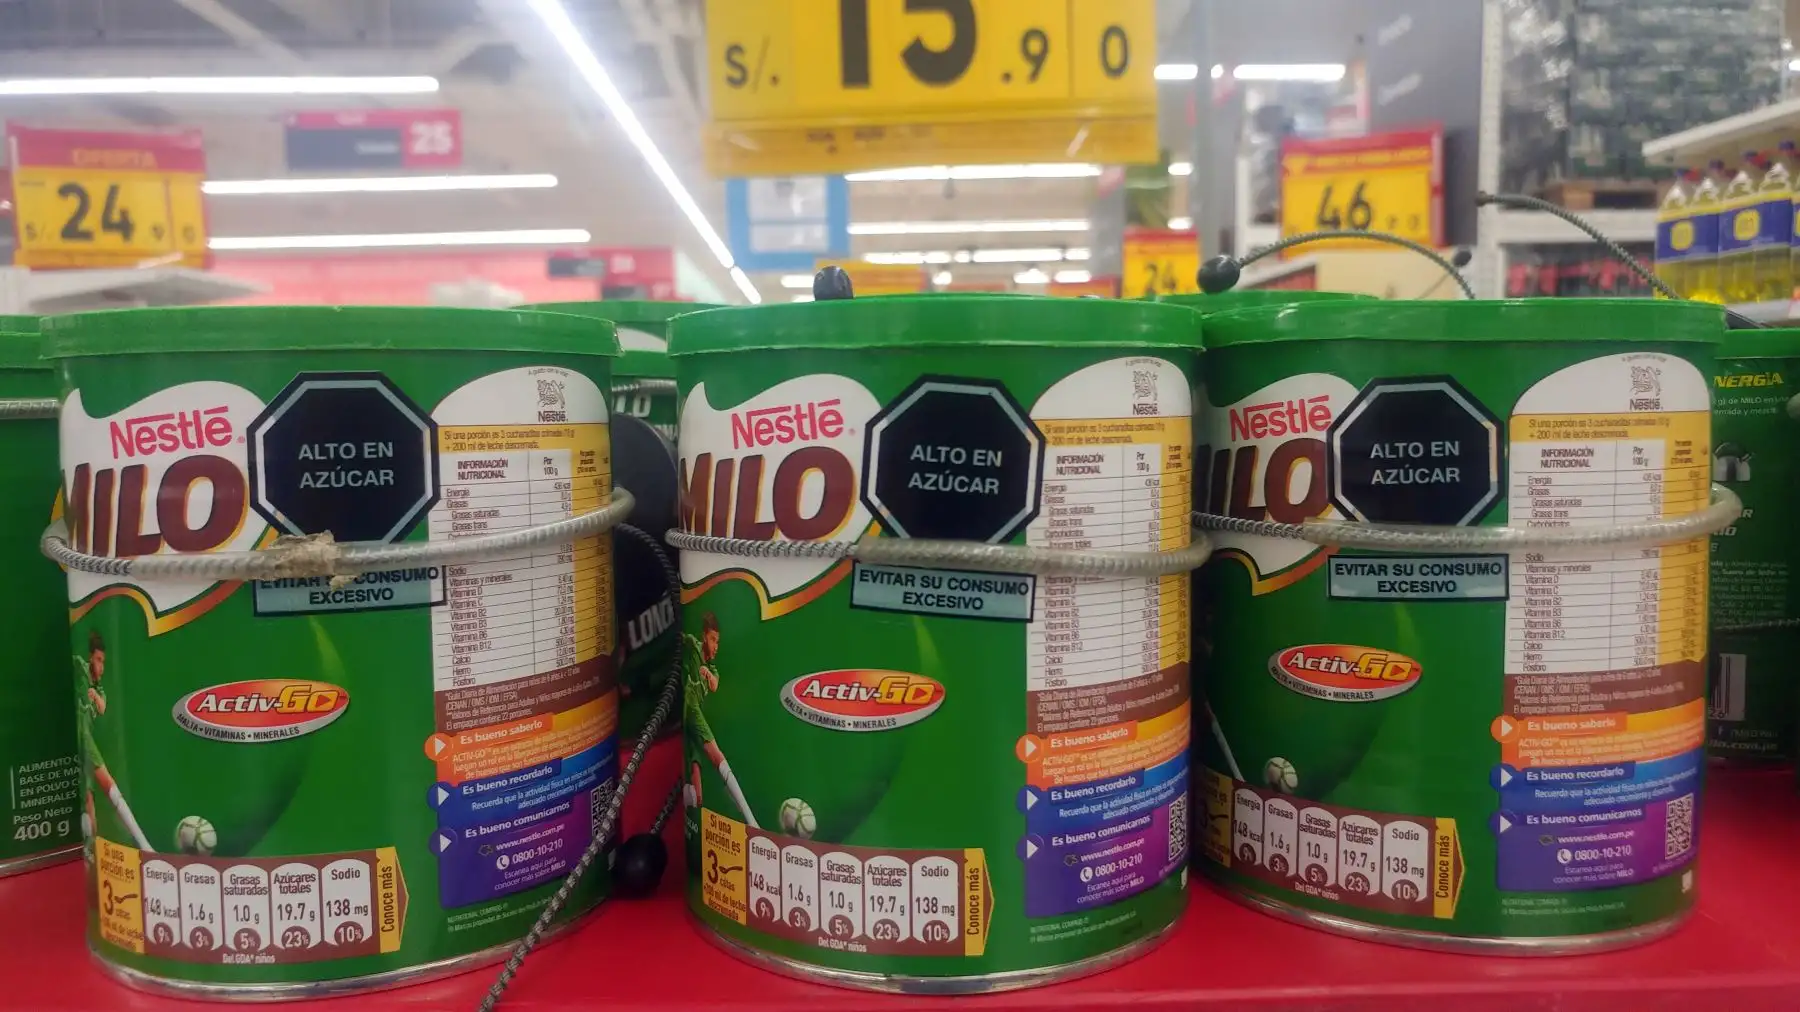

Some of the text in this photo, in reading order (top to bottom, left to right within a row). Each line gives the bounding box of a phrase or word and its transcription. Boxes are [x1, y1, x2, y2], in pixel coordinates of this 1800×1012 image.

[839, 0, 977, 89] 15
[1101, 25, 1128, 78] 0
[58, 181, 134, 242] 24
[1229, 395, 1332, 442] Nestlé
[299, 442, 394, 460] ALTO EN
[910, 445, 1002, 468] ALTO EN
[1370, 440, 1460, 459] ALTO EN
[300, 465, 394, 489] AZÚCAR
[908, 471, 1000, 495] AZÚCAR
[1371, 464, 1460, 485] AZÚCAR
[680, 446, 855, 541] MILO
[357, 567, 439, 584] CONSUMO
[1335, 562, 1502, 576] EVITAR SU CONSUMO
[859, 569, 1029, 596] EVITAR SU CONSUMO
[1377, 580, 1457, 593] EXCESIVO
[310, 588, 394, 605] EXCESIVO
[902, 592, 984, 611] EXCESIVO
[1293, 682, 1327, 697] VITAMINAS
[1333, 691, 1374, 699] MINERALES
[785, 697, 897, 729] MALTA VITAMINAS MINERALES
[176, 713, 300, 740] MALTA VITAMINAS MINERALES
[460, 720, 543, 745] Es bueno saberlo
[1527, 719, 1616, 731] Es bueno saberlo
[1051, 728, 1128, 748] Es bueno saberlo
[19, 756, 72, 773] ALIMENTO
[20, 774, 45, 785] BASE
[48, 771, 61, 779] DE
[462, 765, 553, 796] Es bueno recordarlo
[1527, 768, 1624, 781] Es bueno recordarlo
[20, 780, 69, 797] EN POLVO
[1051, 775, 1136, 801] Es bueno recordarlo
[21, 790, 77, 809] MINERALES
[13, 806, 73, 825] Peso Neto
[465, 801, 570, 839] Es bueno comunicarnos
[710, 814, 717, 828] Si
[718, 820, 732, 834] una
[1526, 808, 1642, 824] Es bueno comunicarnos
[14, 820, 70, 841] 400 g
[1052, 814, 1150, 847] Es bueno comunicarnos
[1392, 828, 1420, 841] Sodio
[512, 838, 564, 864] 0800-10-210
[732, 842, 741, 853] es
[751, 842, 777, 860] Energía
[1575, 845, 1631, 861] 0800-10-210
[707, 849, 718, 884] 3
[785, 852, 814, 868] Grasas
[826, 860, 855, 874] Grasas
[1095, 852, 1143, 877] 0800-10-210
[1386, 856, 1424, 878] 138 mg
[1435, 835, 1450, 899] Conoce más
[331, 868, 361, 880] Sodio
[820, 872, 862, 886] saturadas
[866, 863, 907, 877] Azúcares
[921, 866, 949, 877] Sodio
[749, 871, 764, 891] 148
[872, 876, 902, 888] totales
[381, 865, 395, 933] Conoce más
[788, 882, 812, 906] 1.6 g
[829, 890, 854, 912] 1.0 g
[966, 868, 980, 936] Conoce más
[326, 900, 369, 917] 138 mg
[870, 895, 905, 916] 19.7 g
[915, 897, 955, 916] 138 mg
[818, 936, 829, 947] Del
